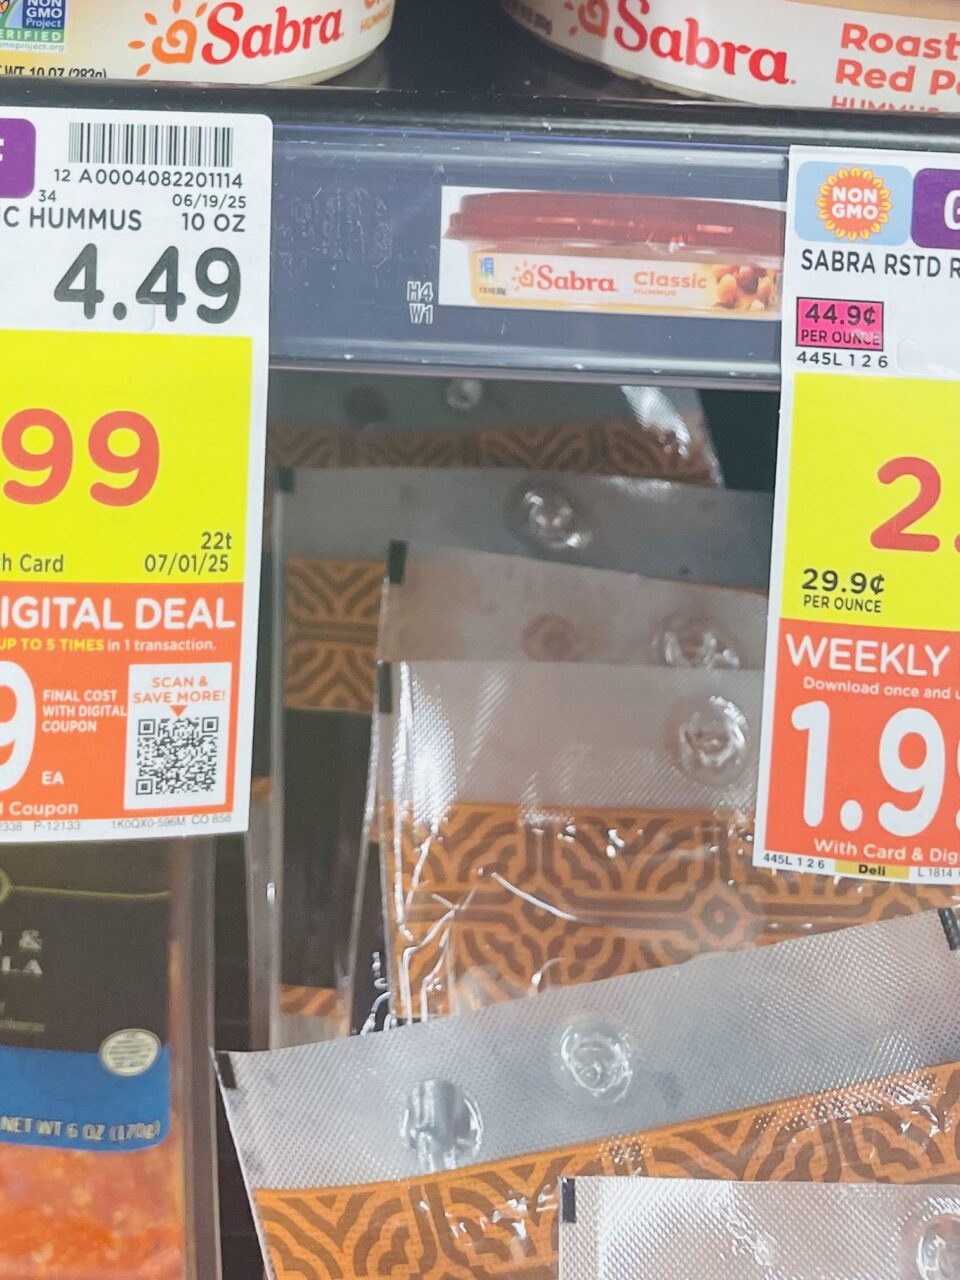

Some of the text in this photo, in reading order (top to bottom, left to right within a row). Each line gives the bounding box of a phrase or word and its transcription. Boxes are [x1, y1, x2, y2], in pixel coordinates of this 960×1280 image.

[26, 7, 62, 18] GMO
[26, 18, 61, 28] Project
[201, 1, 342, 65] Sabra
[835, 58, 916, 93] Red
[54, 169, 71, 182] 12
[39, 190, 56, 203] 34
[172, 193, 247, 210] 06/19/25
[832, 187, 877, 203] NON
[29, 206, 142, 231] HUMMUS
[832, 205, 878, 219] GMO
[182, 212, 246, 232] 10 OZ
[801, 248, 875, 274] SABRA
[884, 254, 941, 277] RSTD
[53, 242, 242, 324] 4.49
[537, 264, 615, 292] Sabra
[634, 271, 707, 289] Classic
[805, 303, 876, 326] 44.9¢
[801, 330, 880, 346] PER OUNCE
[796, 351, 842, 367] 445L
[201, 531, 233, 550] 22t
[20, 553, 64, 572] Card
[144, 552, 229, 575] 07/01/25
[801, 568, 885, 595] 29.9¢
[803, 594, 881, 613] PER OUNCE
[135, 597, 236, 630] DEAL
[21, 638, 42, 651] TO
[60, 638, 105, 652] TIMES
[134, 639, 216, 652] transaction.
[785, 632, 950, 677] WEEKLY
[152, 677, 194, 688] SCAN
[803, 676, 879, 695] Download
[884, 684, 919, 697] once
[923, 687, 951, 700] and
[43, 689, 118, 702] FINAL COST
[133, 690, 226, 704] SAVE MORE!
[42, 705, 128, 717] WITH DIGITAL
[41, 720, 97, 732] COUPON
[41, 771, 64, 785] EA
[9, 802, 79, 820] Coupon
[33, 821, 81, 832] P-12133
[814, 838, 907, 861] With Card
[763, 852, 886, 876] 445L Deli
